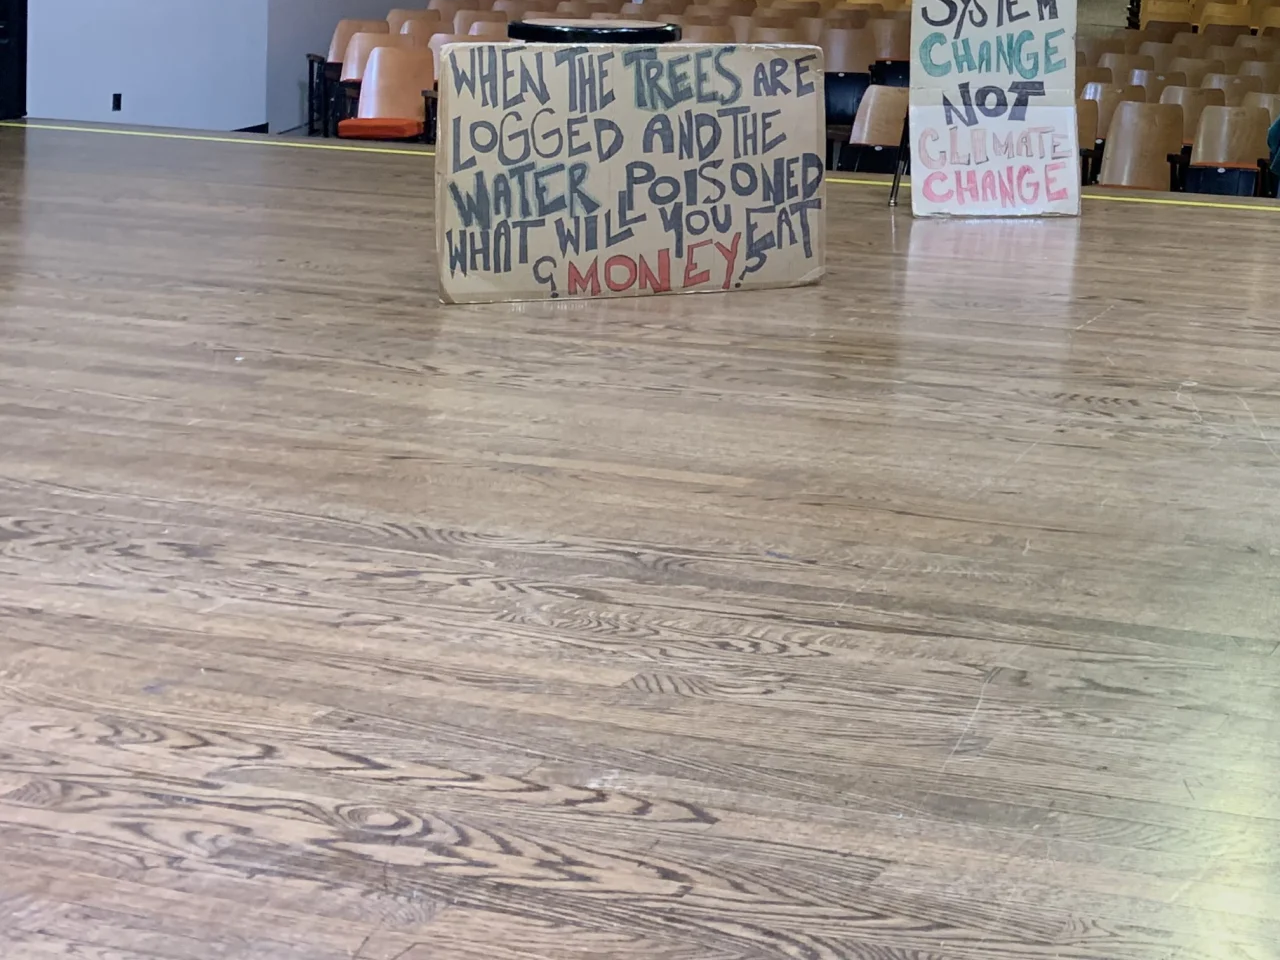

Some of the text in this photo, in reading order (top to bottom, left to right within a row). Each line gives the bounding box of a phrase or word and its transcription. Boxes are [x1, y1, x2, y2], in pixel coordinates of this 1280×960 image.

[449, 46, 817, 113] WHEN THE TREES ARE
[919, 28, 1067, 79] CHANGE
[942, 81, 1046, 127] NOT
[452, 106, 787, 174] LOGGED AND THE
[918, 126, 1072, 169] CLIMATE
[449, 153, 823, 230] WATER POISONED
[922, 162, 1069, 208] CHANGE
[446, 190, 822, 279] WHAT WILL YOU EAT
